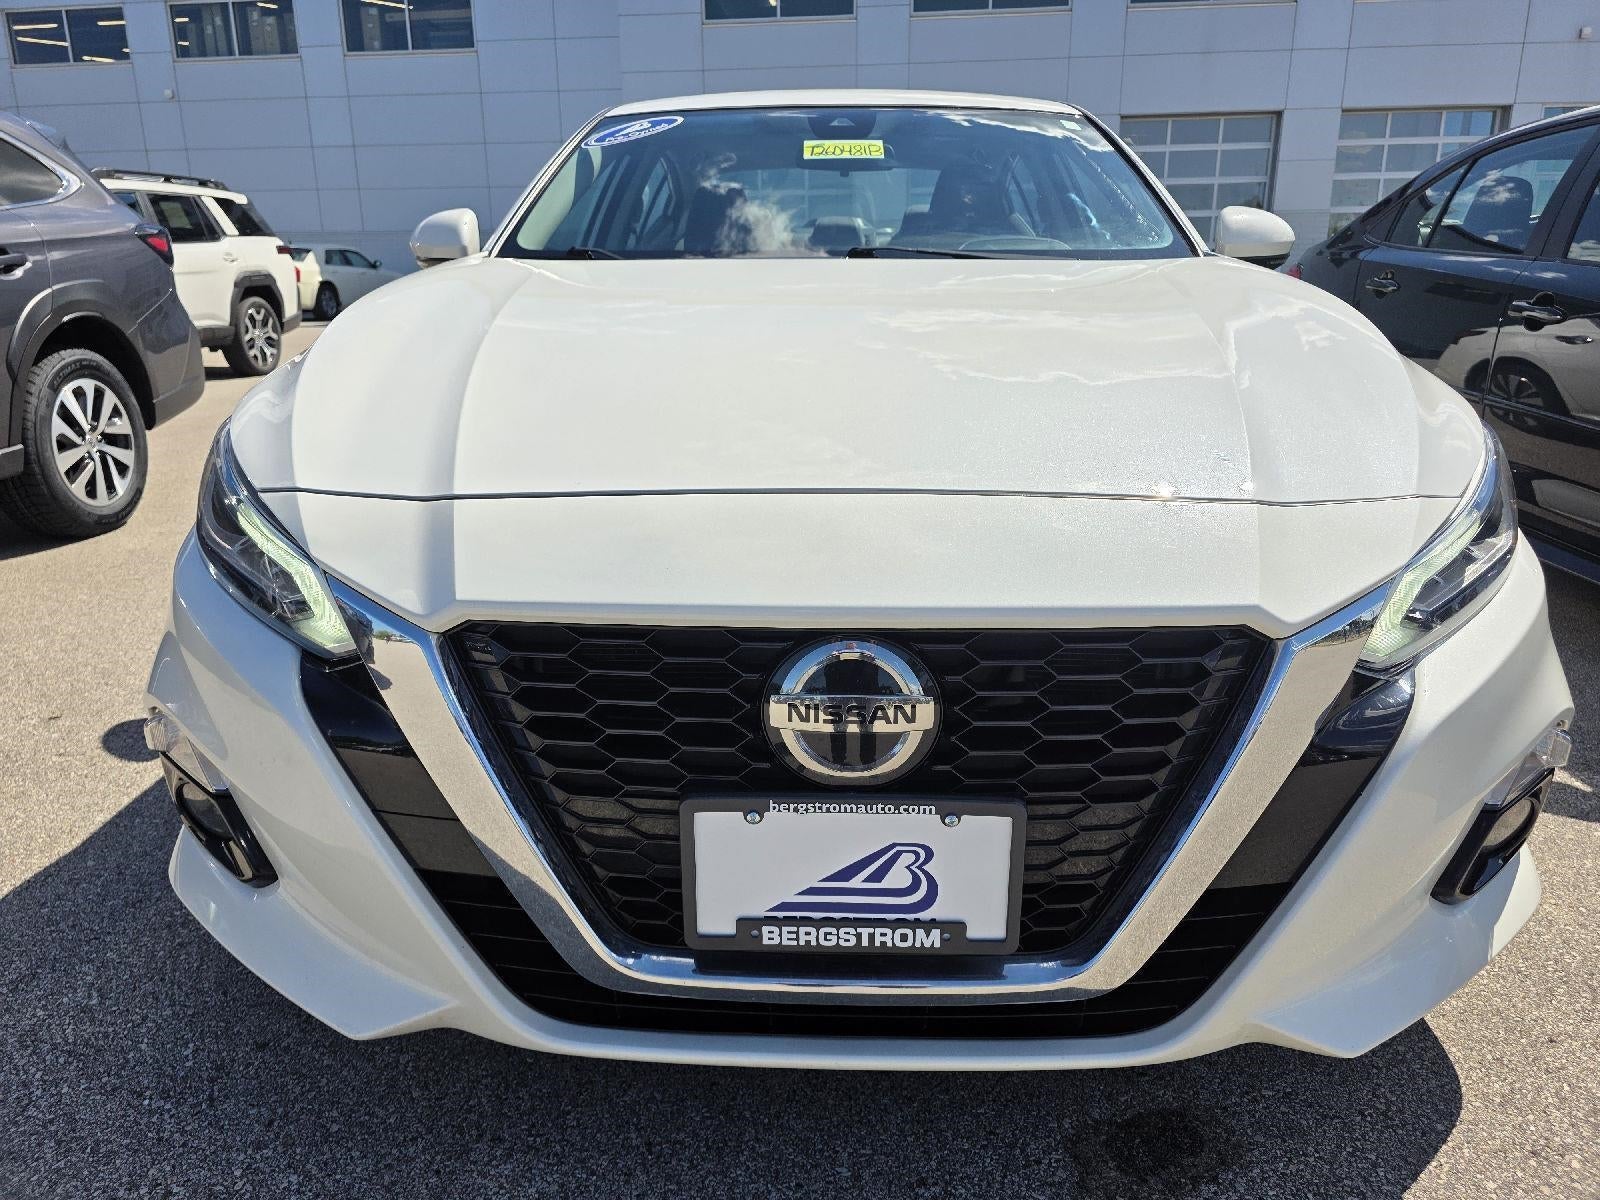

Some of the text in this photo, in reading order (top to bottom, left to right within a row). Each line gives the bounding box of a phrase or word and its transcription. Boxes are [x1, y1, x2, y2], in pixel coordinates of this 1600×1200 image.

[787, 702, 917, 725] NISSAN
[768, 799, 937, 816] bergstromauto.com
[761, 925, 942, 948] BERGSTROM
